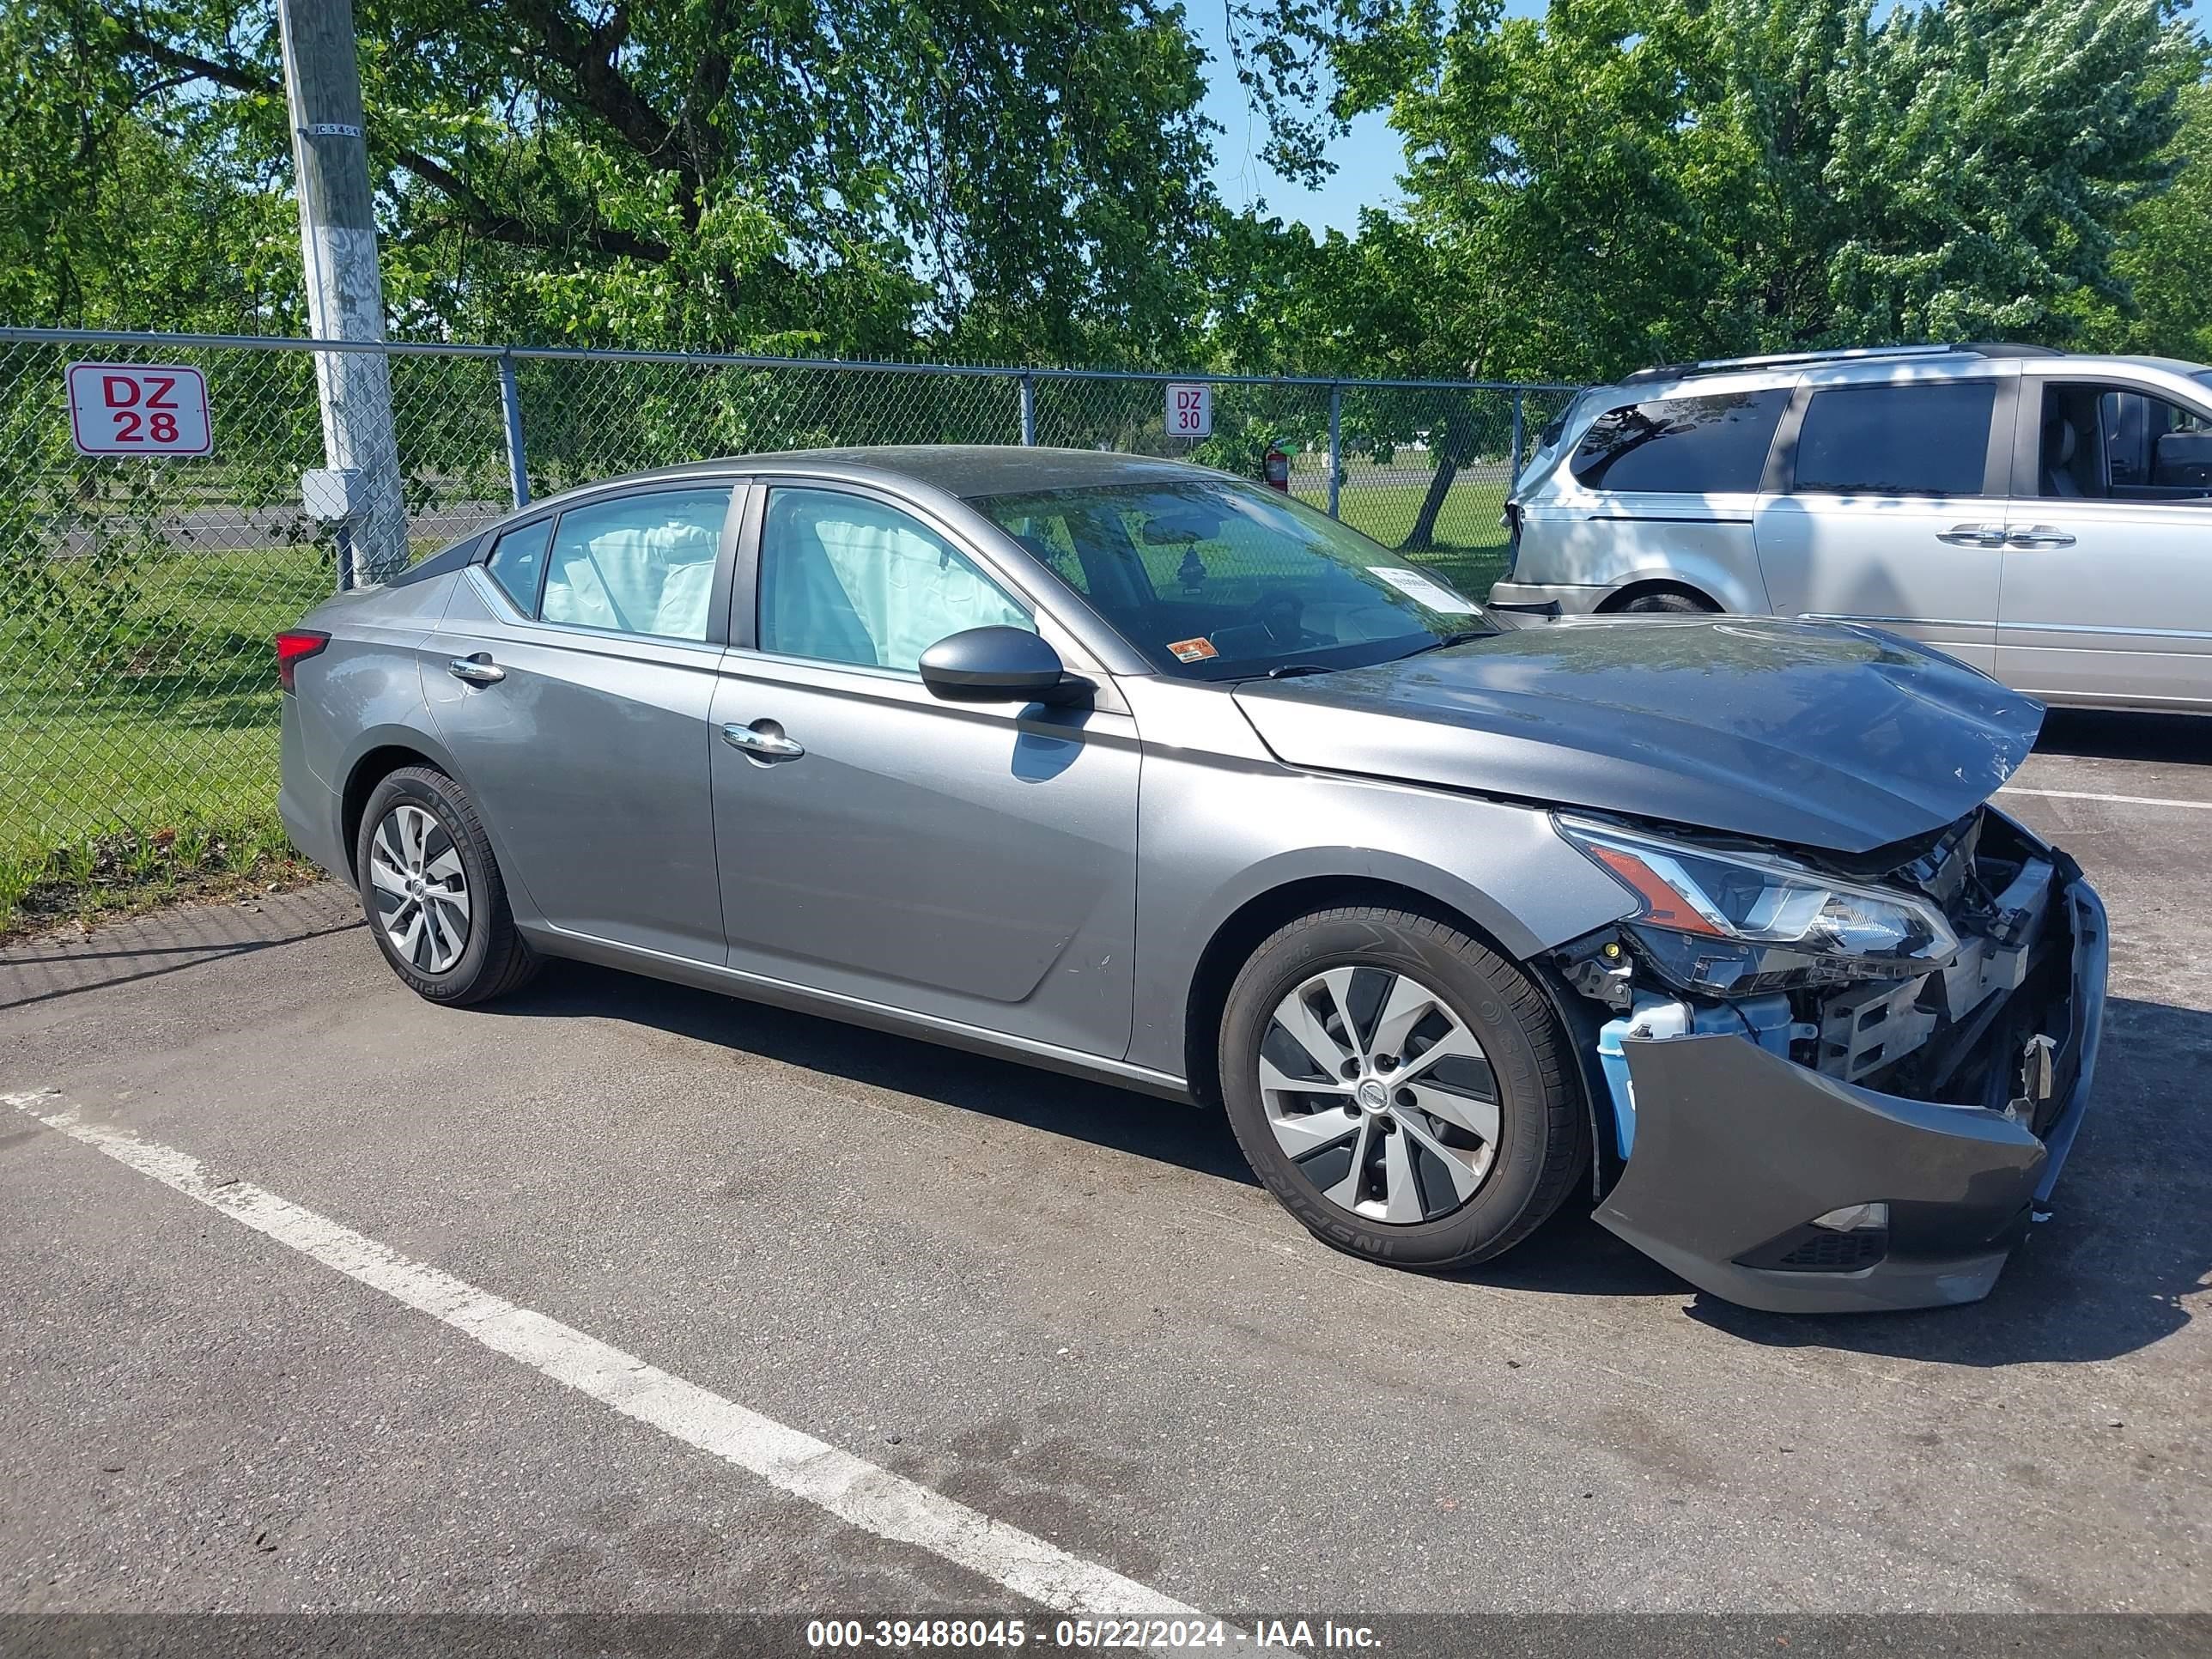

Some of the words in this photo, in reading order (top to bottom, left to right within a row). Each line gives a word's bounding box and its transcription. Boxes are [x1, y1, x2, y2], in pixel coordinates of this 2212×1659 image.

[102, 375, 179, 409] DZ
[1177, 391, 1201, 410] DZ
[112, 410, 179, 443] 28
[1178, 411, 1200, 429] 30
[396, 966, 462, 996] INSPIRE
[1252, 1150, 1395, 1257] INSPIRE
